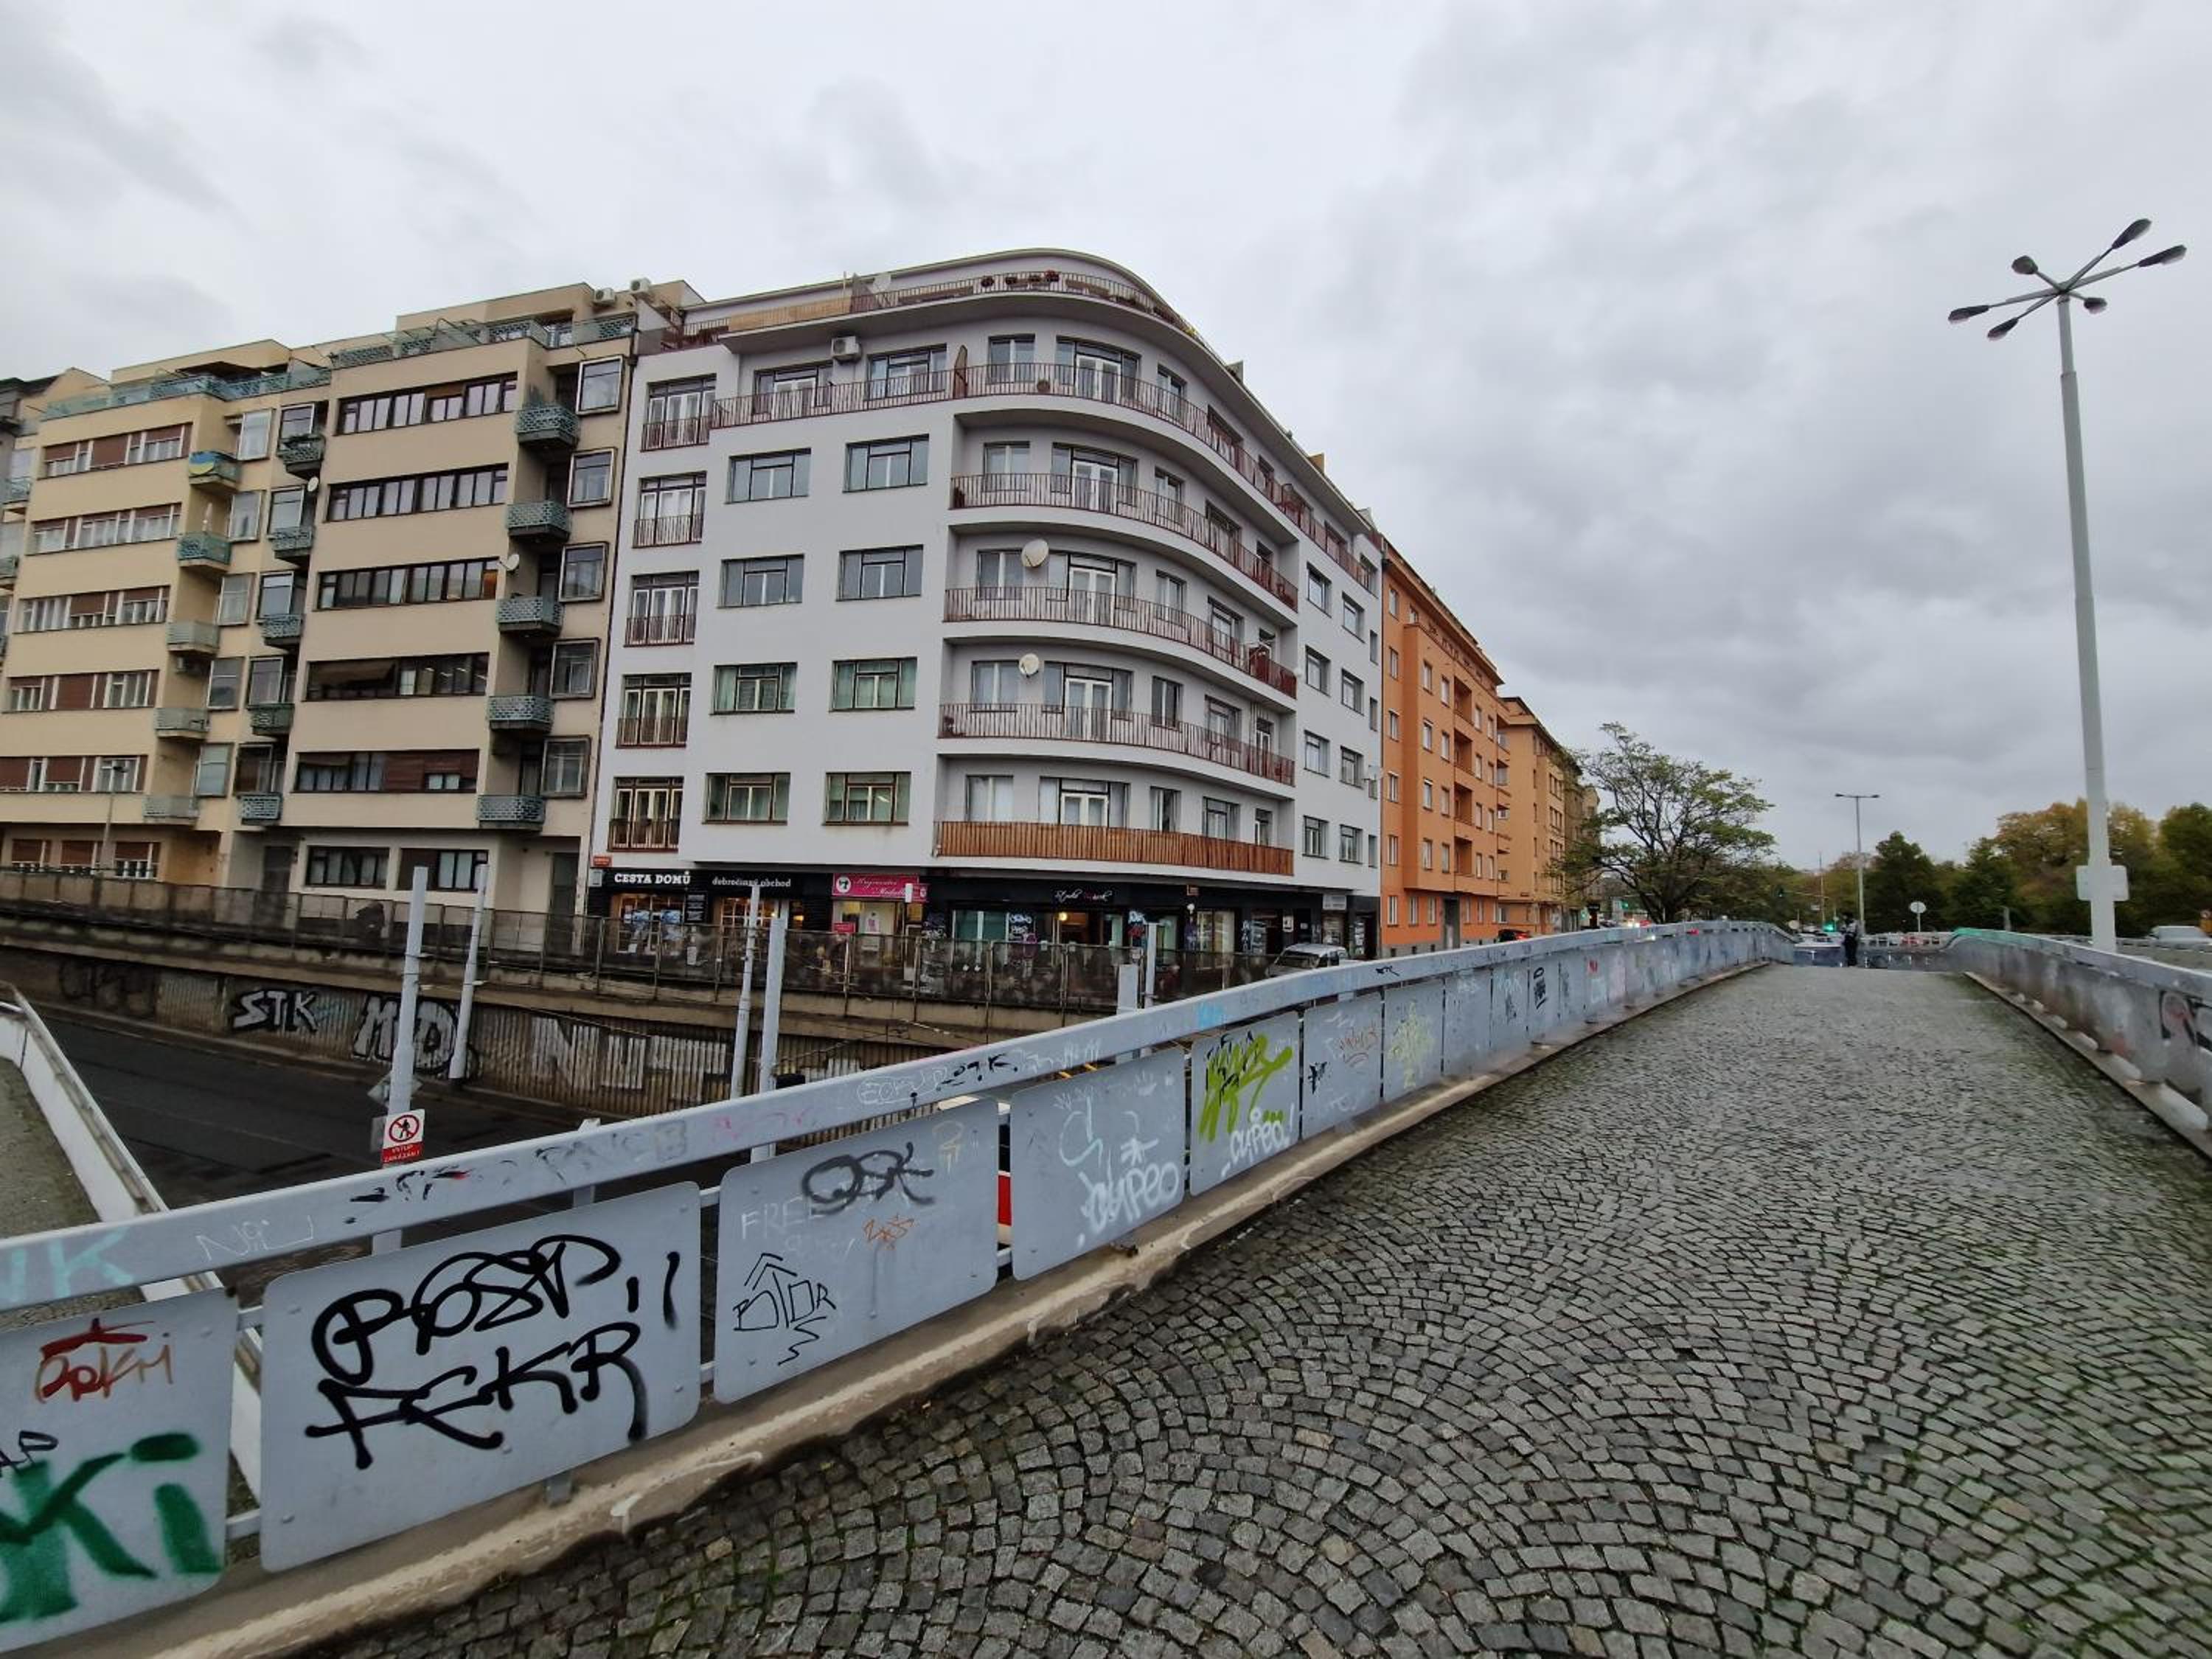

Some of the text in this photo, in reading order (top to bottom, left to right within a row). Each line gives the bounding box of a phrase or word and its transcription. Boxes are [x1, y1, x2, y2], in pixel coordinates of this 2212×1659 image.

[614, 871, 690, 884] CESTA DOMŮ
[760, 879, 791, 887] obchod
